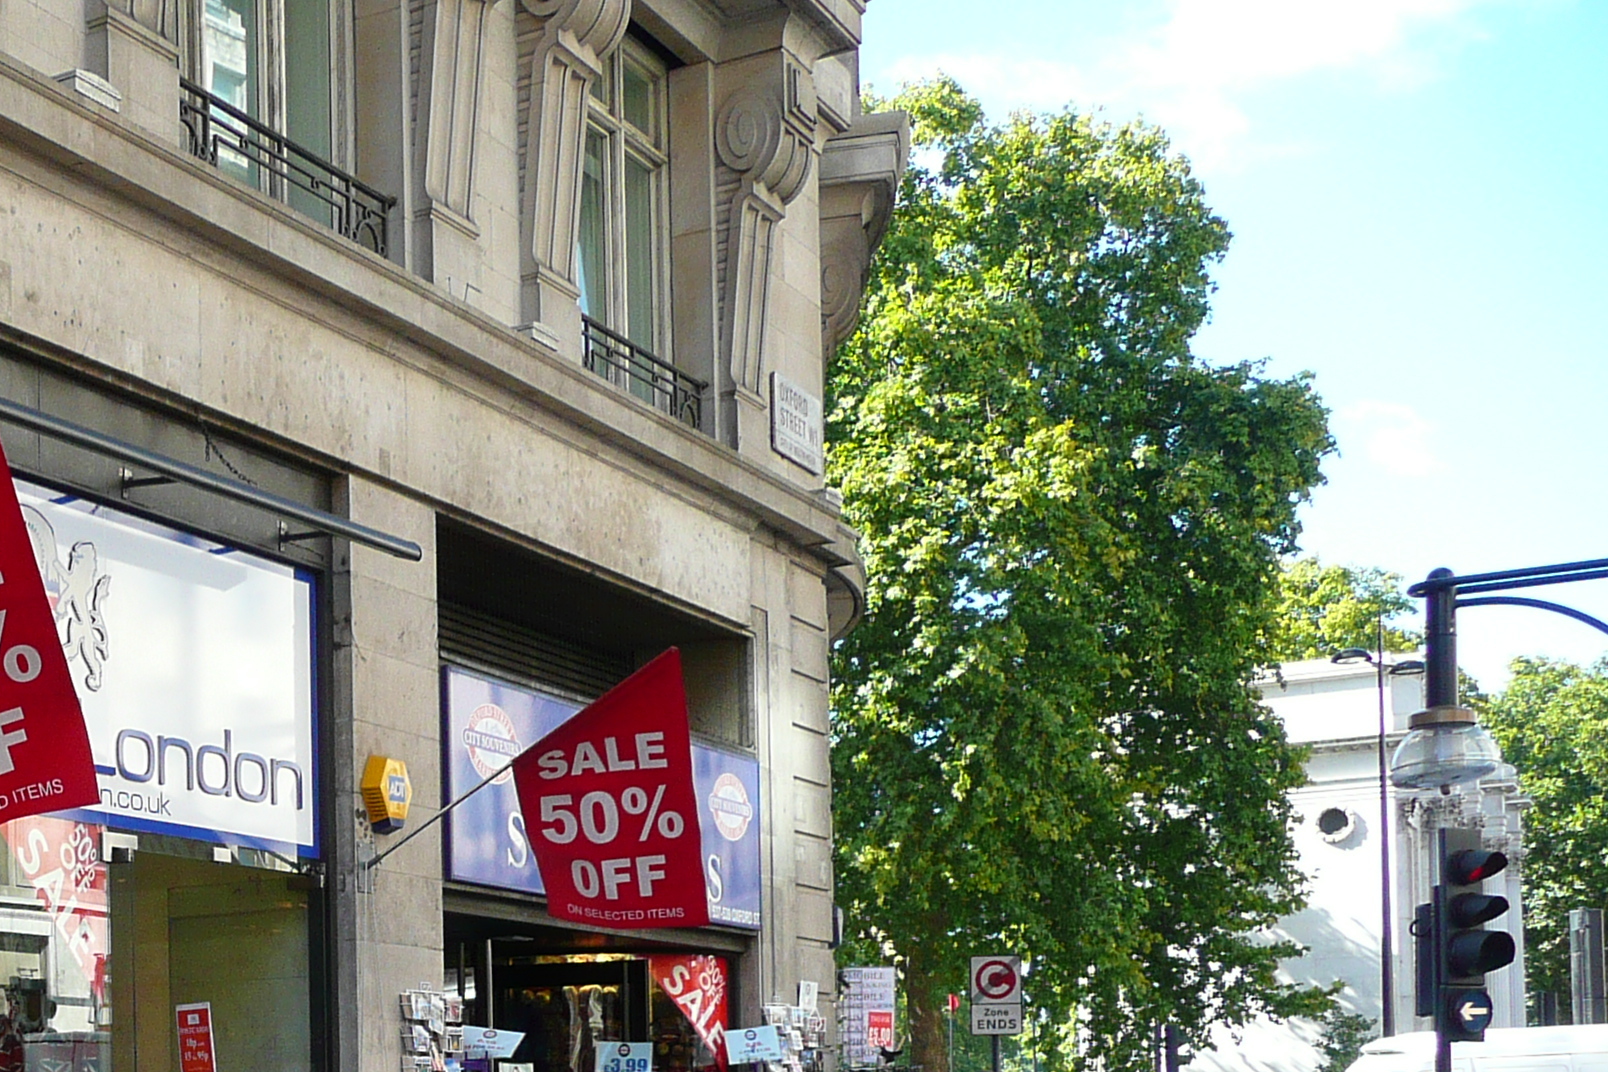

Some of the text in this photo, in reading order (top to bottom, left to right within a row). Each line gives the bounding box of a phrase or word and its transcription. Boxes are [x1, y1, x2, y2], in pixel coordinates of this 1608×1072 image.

[779, 382, 808, 418] OXFORD
[780, 407, 806, 439] STREET
[95, 729, 303, 811] ondon
[537, 731, 668, 780] SALE
[10, 777, 65, 806] ITEMS
[100, 787, 171, 817] n.co.uk
[539, 784, 684, 846] 50%
[571, 854, 666, 901] OFF
[17, 828, 96, 968] SALE
[567, 903, 685, 921] ON SELECTED ITEMS
[664, 964, 725, 1054] SALE
[977, 1018, 1017, 1030] ENDS
[984, 1008, 1009, 1016] Zone
